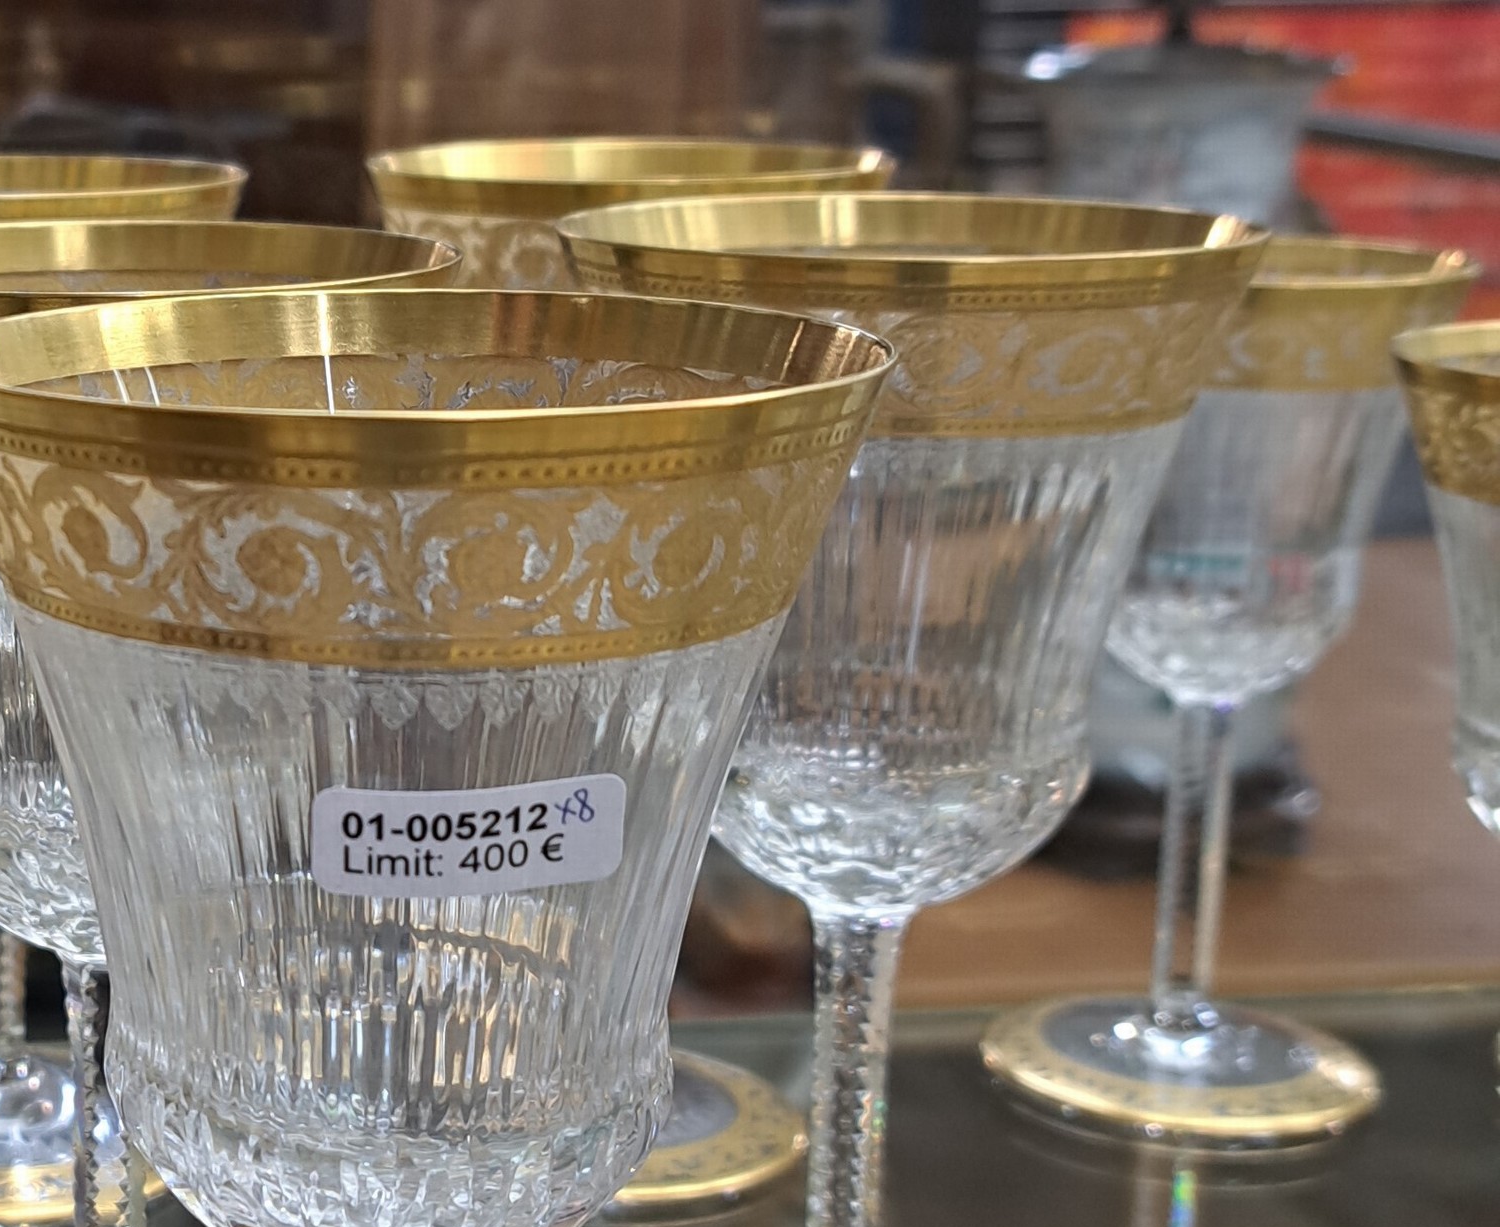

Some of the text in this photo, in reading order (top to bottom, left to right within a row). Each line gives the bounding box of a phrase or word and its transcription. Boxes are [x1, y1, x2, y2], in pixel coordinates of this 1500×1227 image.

[341, 803, 548, 842] 01-005212
[343, 833, 565, 877] Limit: 400 €
